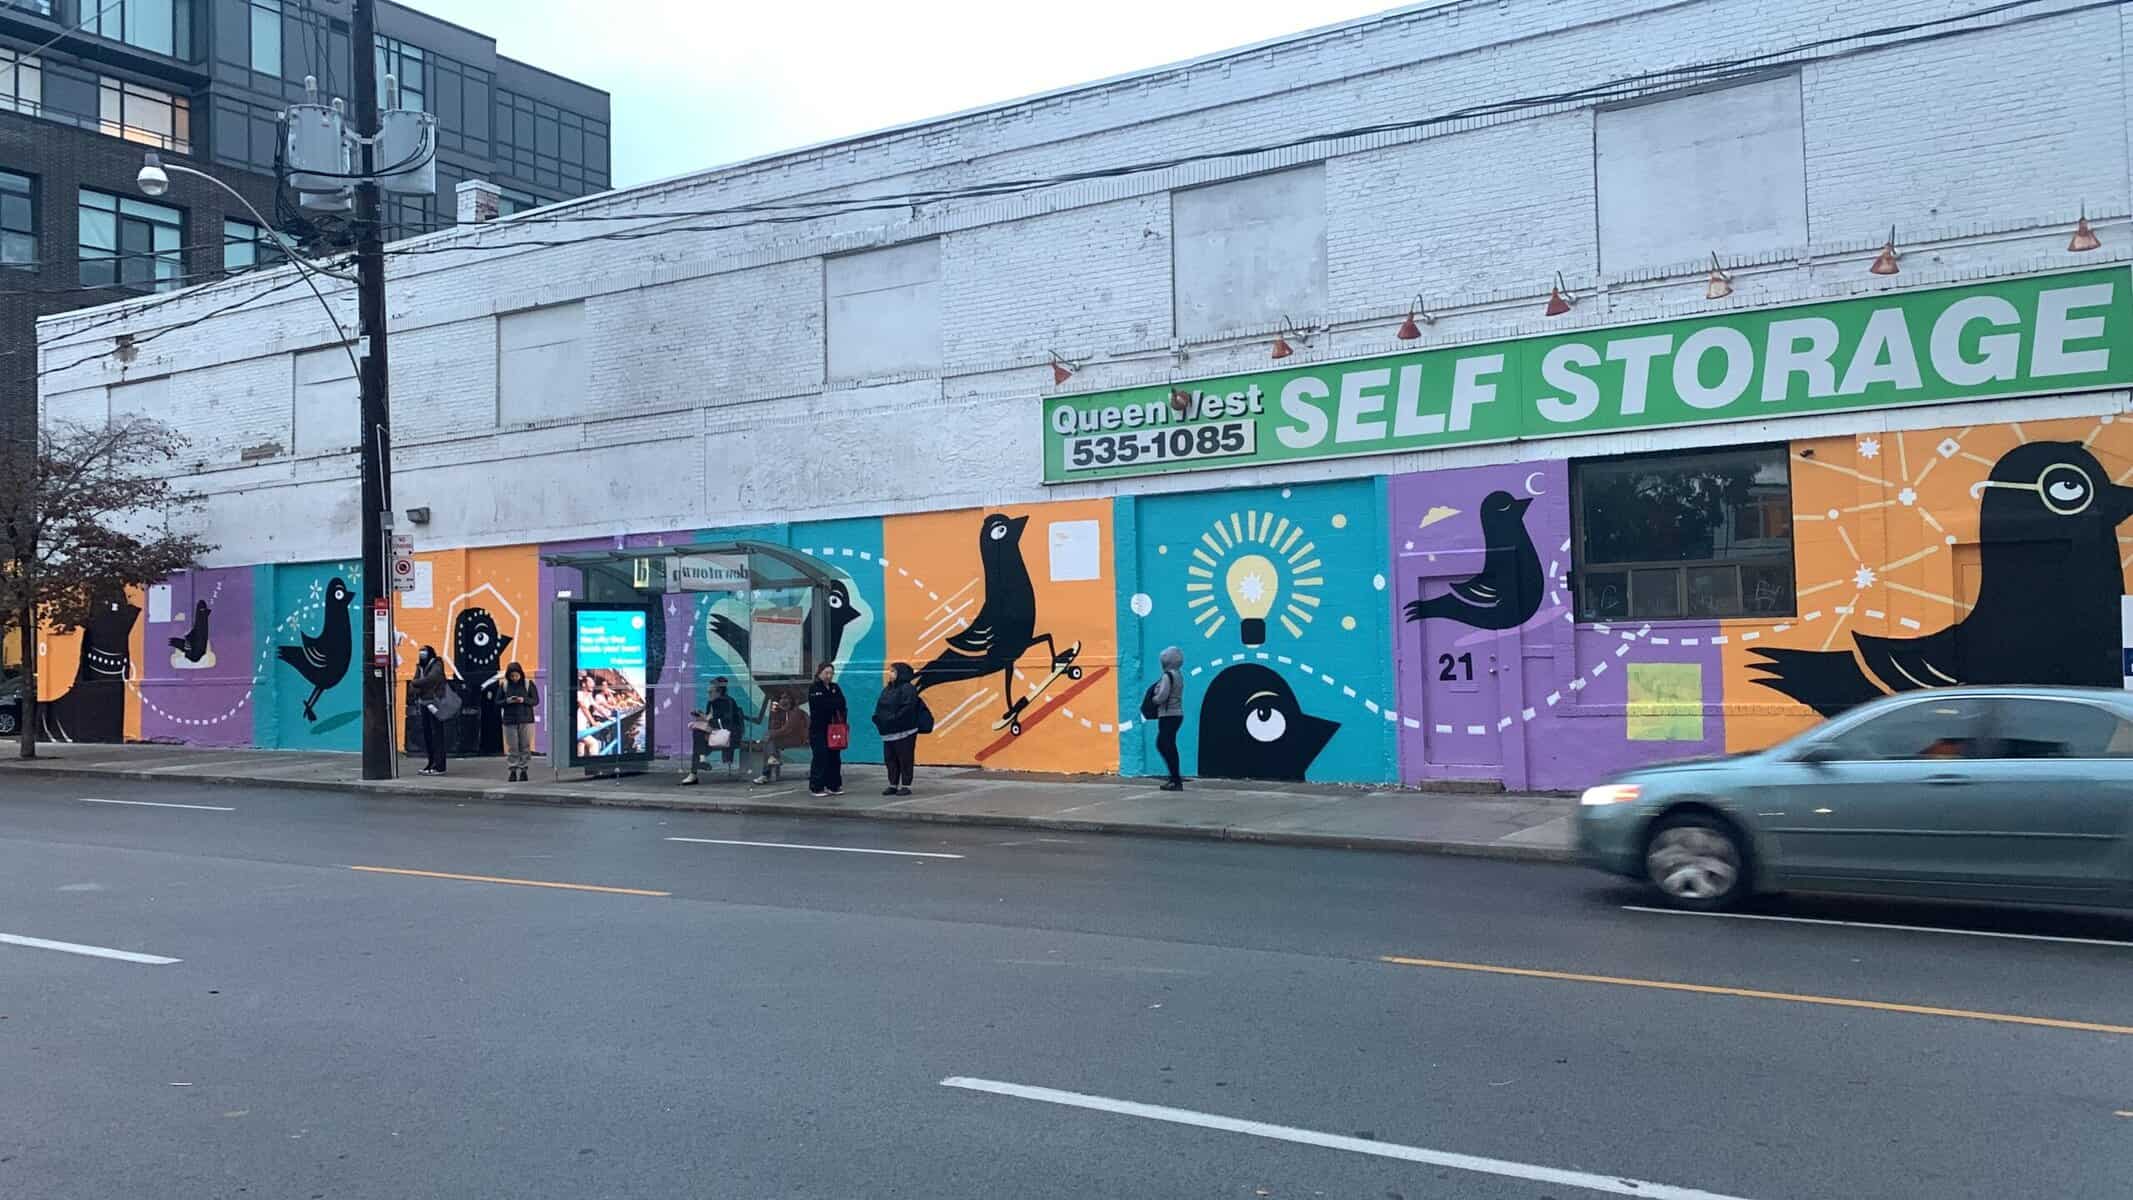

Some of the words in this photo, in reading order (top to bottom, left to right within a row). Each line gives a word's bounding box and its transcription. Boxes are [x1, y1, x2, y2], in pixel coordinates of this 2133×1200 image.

[1275, 354, 1504, 448] SELF
[1536, 282, 2114, 422] STORAGE
[1073, 423, 1245, 466] 535-1085
[1439, 652, 1473, 681] 21
